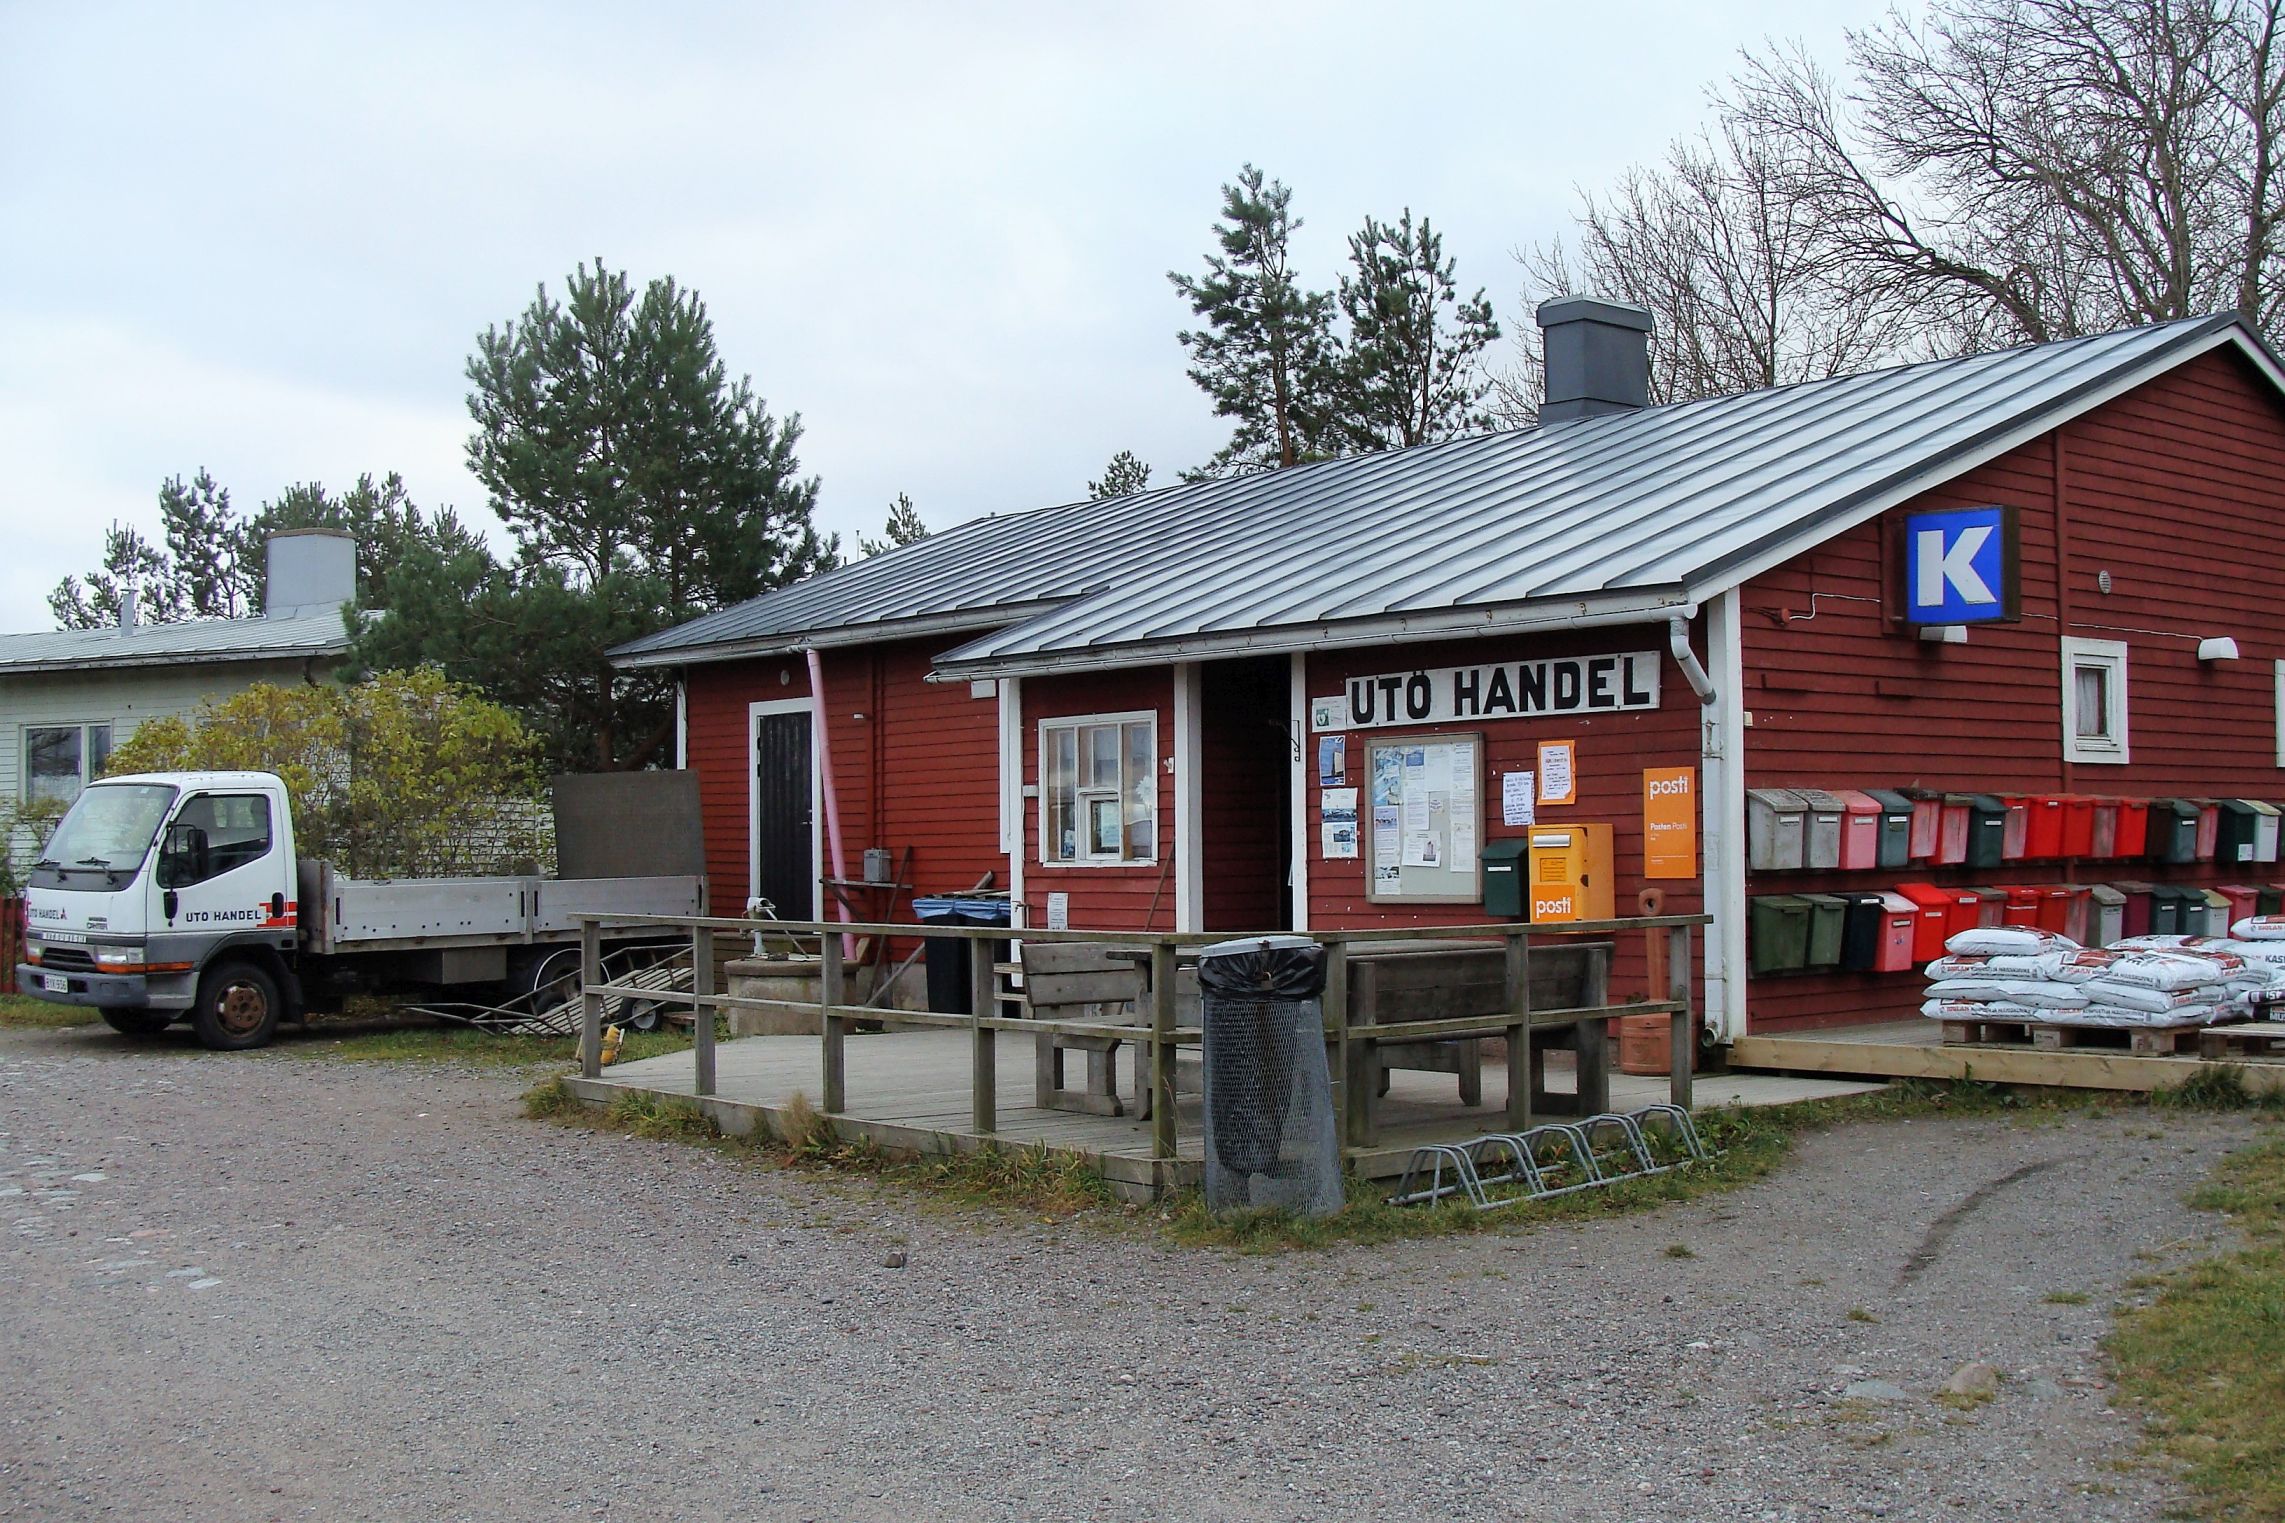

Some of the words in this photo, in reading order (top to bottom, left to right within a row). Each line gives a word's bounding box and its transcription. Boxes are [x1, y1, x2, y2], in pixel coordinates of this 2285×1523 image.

[1917, 525, 1997, 606] K
[1351, 670, 1432, 725] UTÖ
[1453, 656, 1650, 717] HANDEL
[1649, 776, 1689, 800] posti
[214, 910, 262, 921] HANDEL
[1536, 896, 1572, 919] posti
[2265, 954, 2285, 964] KAS
